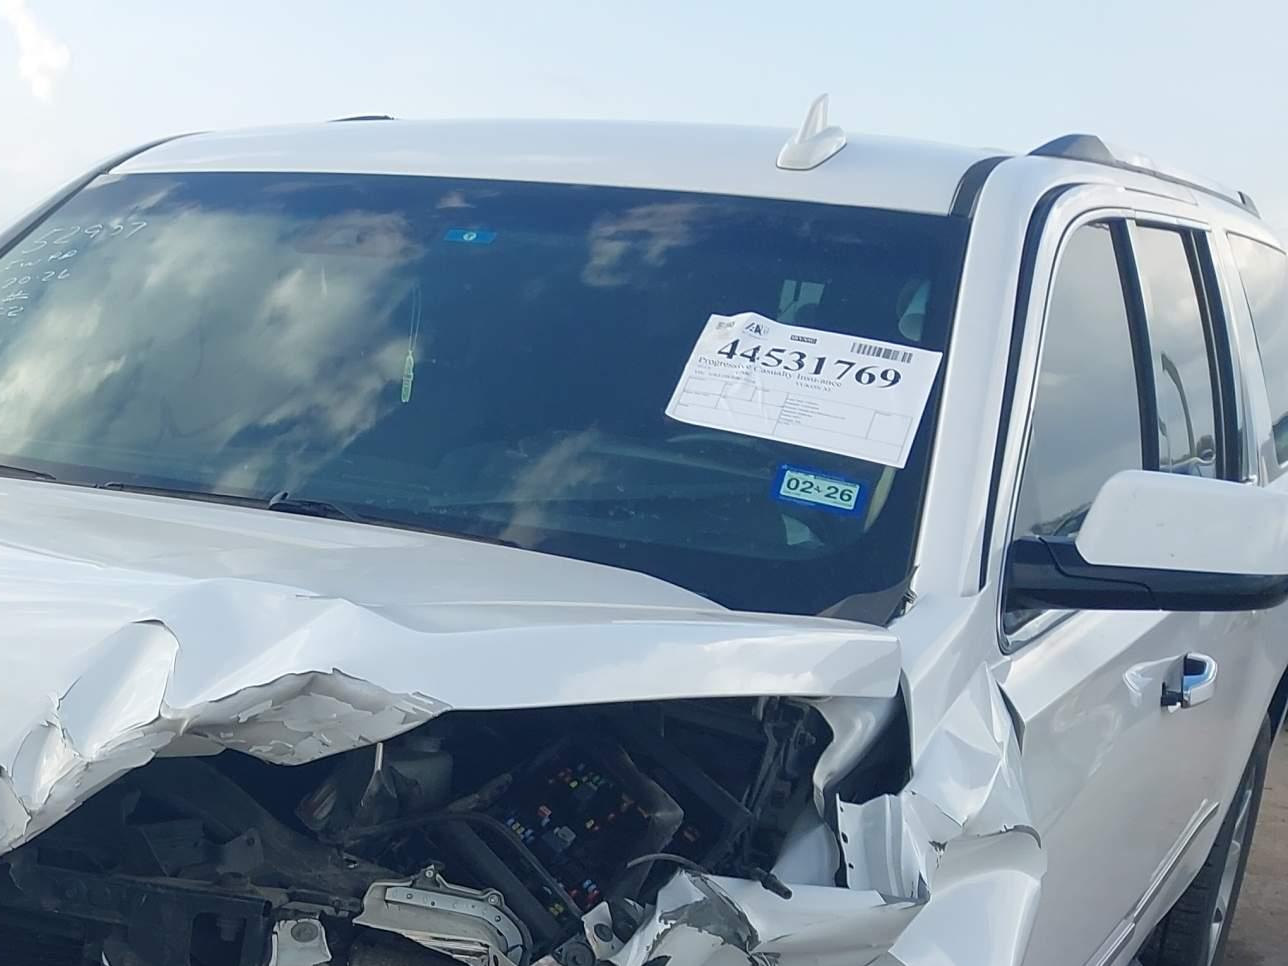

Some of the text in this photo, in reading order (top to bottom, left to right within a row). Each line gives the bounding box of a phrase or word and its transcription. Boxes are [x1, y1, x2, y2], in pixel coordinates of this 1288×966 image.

[717, 338, 902, 389] 44531769
[786, 477, 854, 502] 02 26
